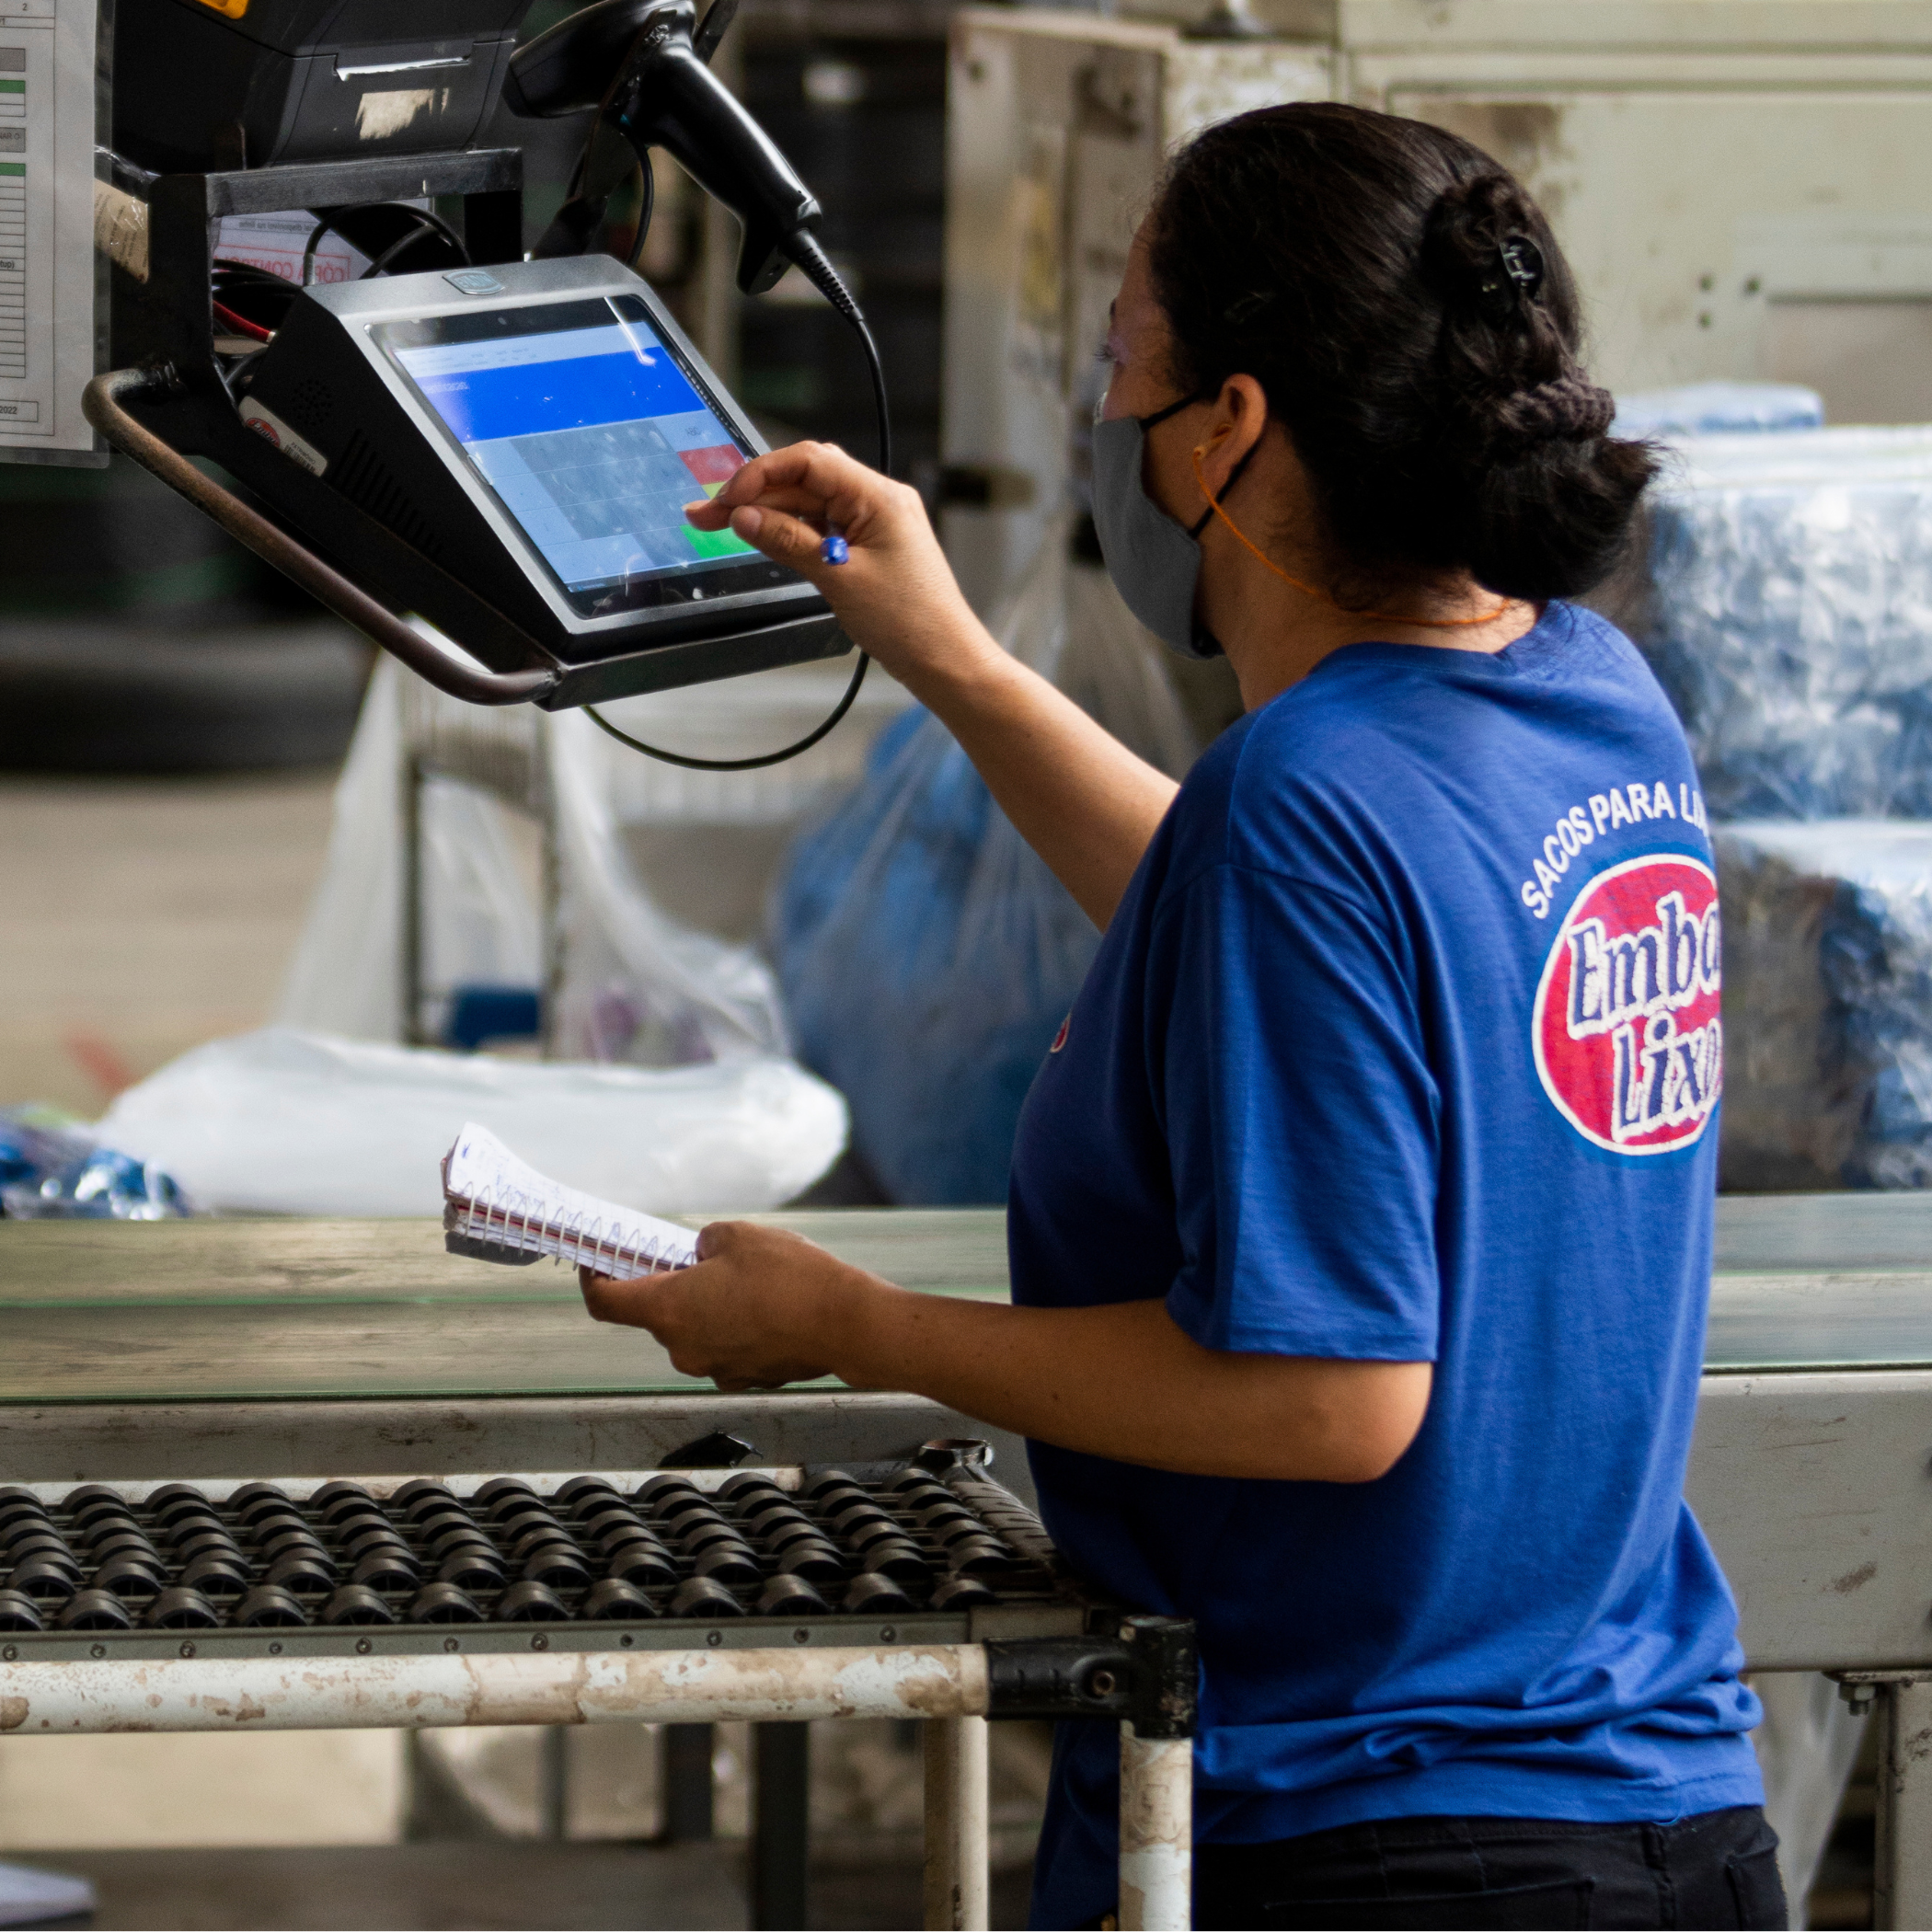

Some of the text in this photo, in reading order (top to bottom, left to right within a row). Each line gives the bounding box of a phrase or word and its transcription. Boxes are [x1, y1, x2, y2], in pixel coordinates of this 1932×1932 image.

[22, 3, 28, 11] 2
[1521, 806, 1594, 919] SACOS
[1588, 781, 1675, 834] PARA
